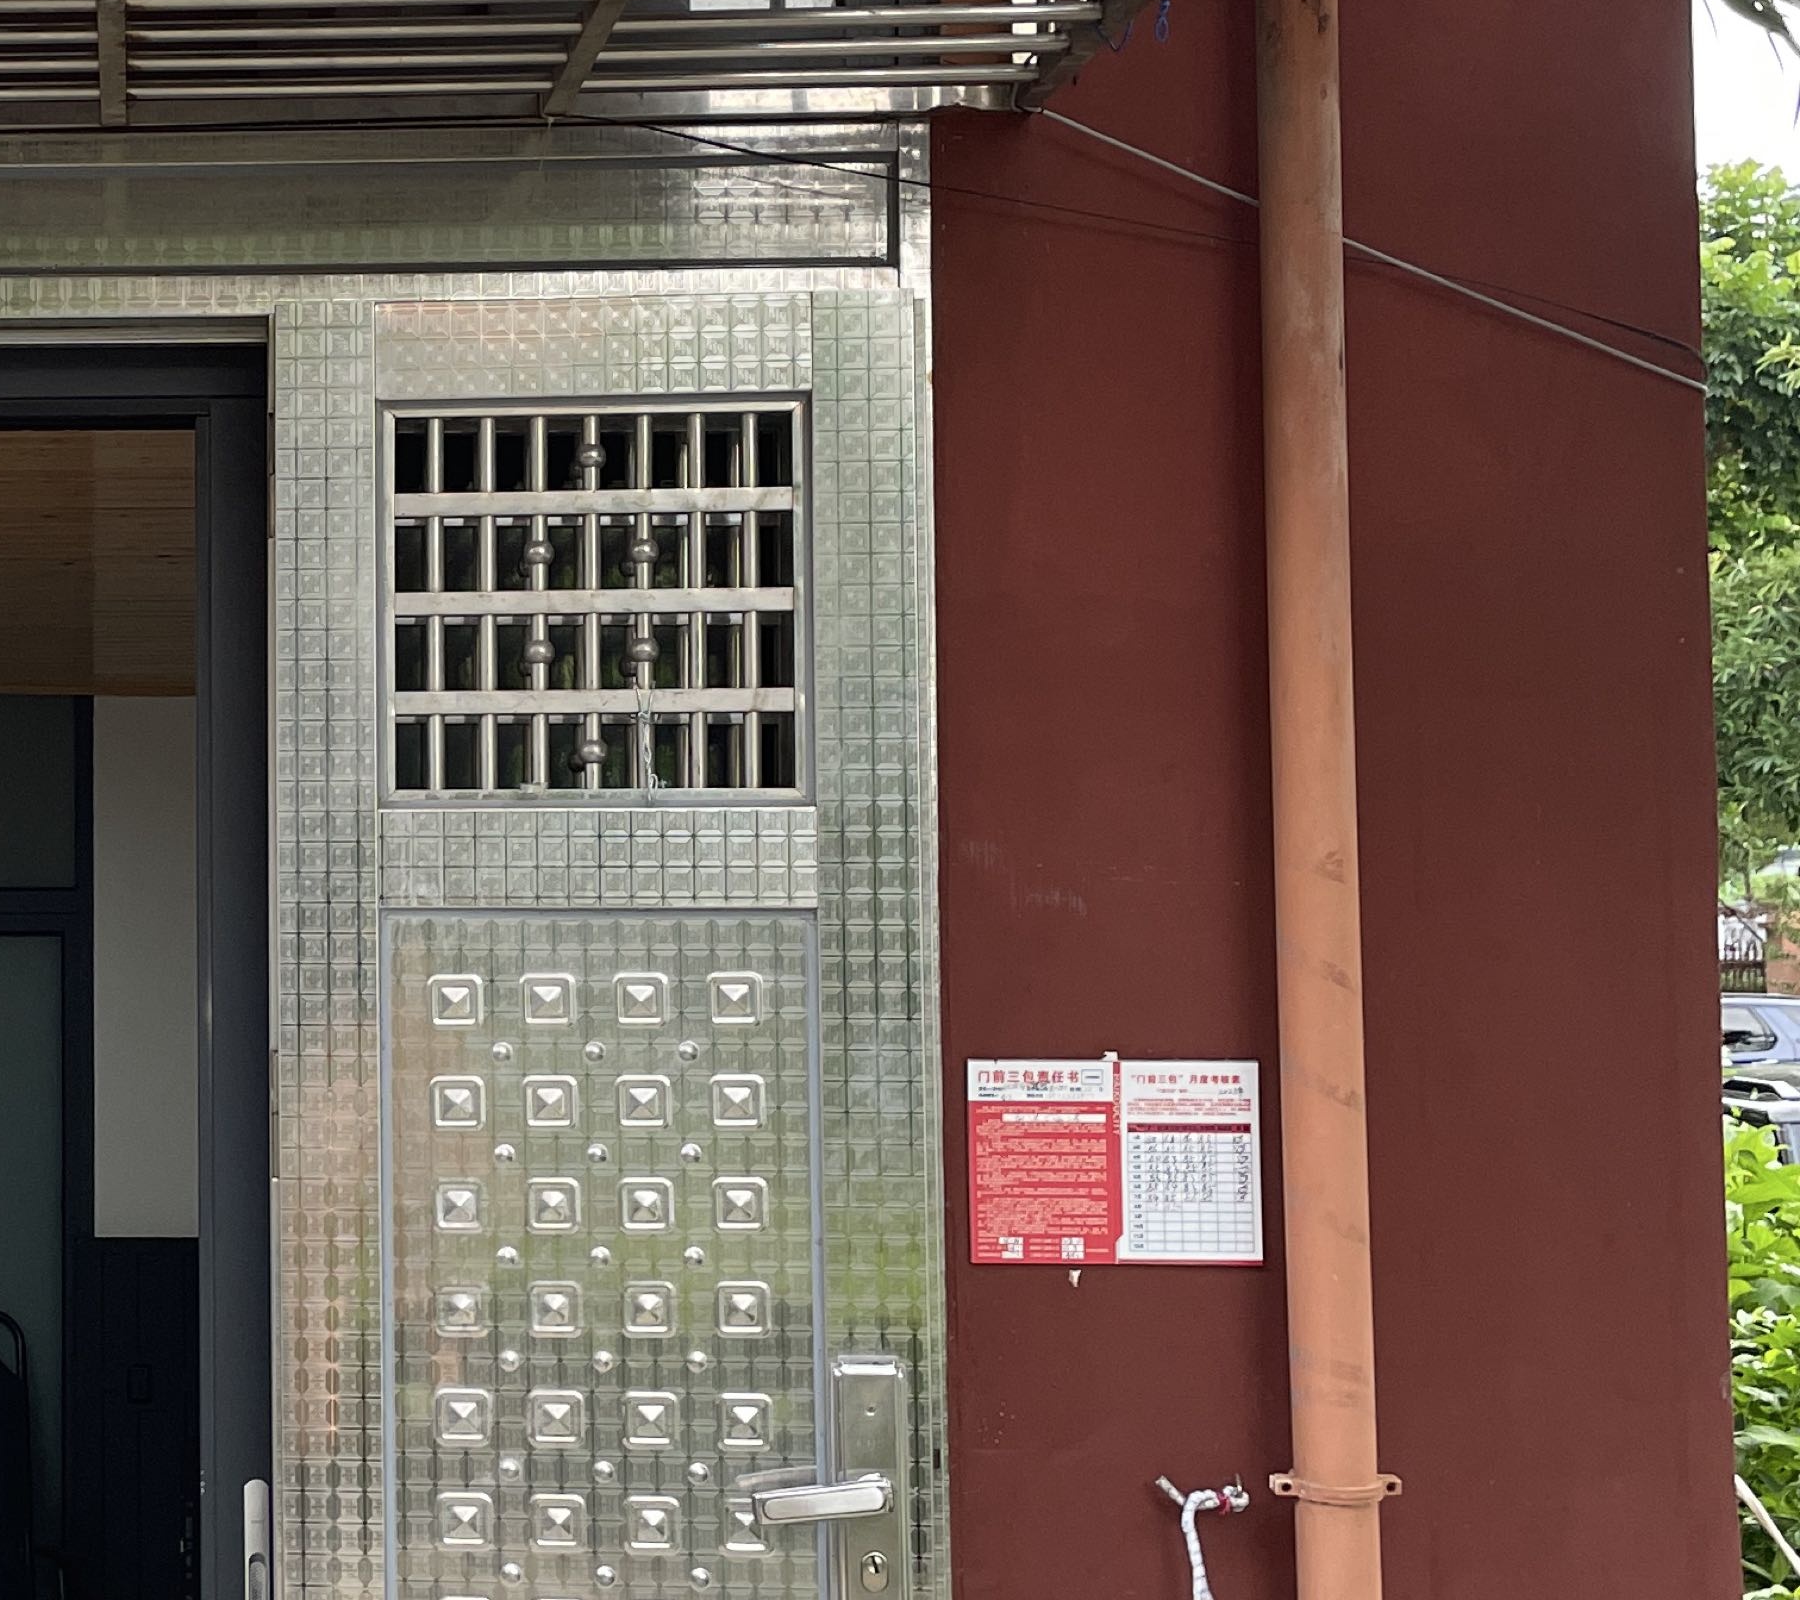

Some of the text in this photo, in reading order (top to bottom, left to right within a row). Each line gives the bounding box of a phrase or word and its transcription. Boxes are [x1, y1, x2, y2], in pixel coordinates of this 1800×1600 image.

[977, 1069, 1080, 1084] 门前三包责任书
